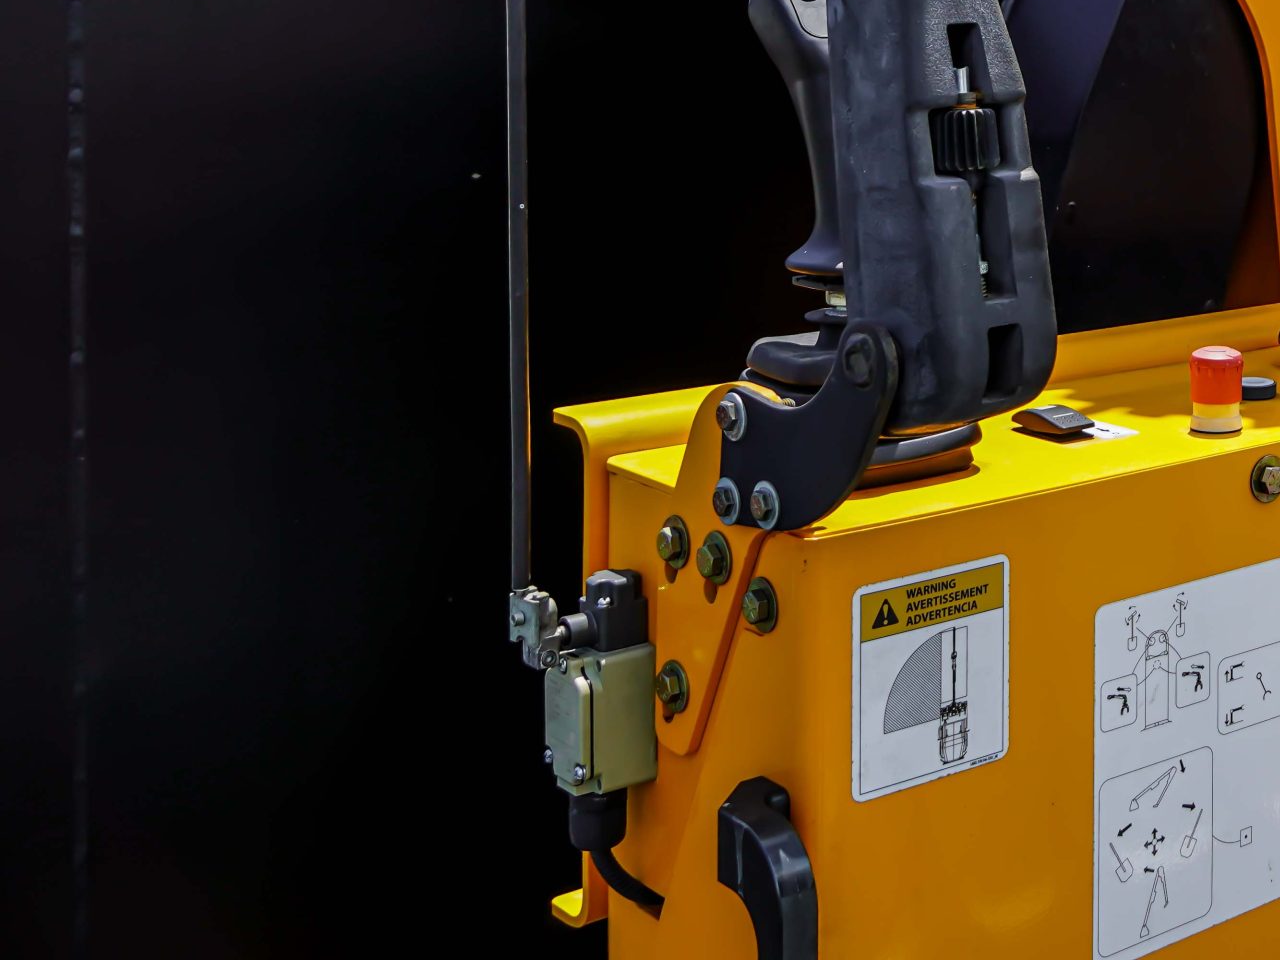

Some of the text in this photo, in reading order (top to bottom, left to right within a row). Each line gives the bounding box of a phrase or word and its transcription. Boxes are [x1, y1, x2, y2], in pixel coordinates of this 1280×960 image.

[906, 578, 957, 599] WARNING
[906, 583, 989, 613] AVERTISSEMENT
[906, 600, 978, 627] ADVERTENCIA
